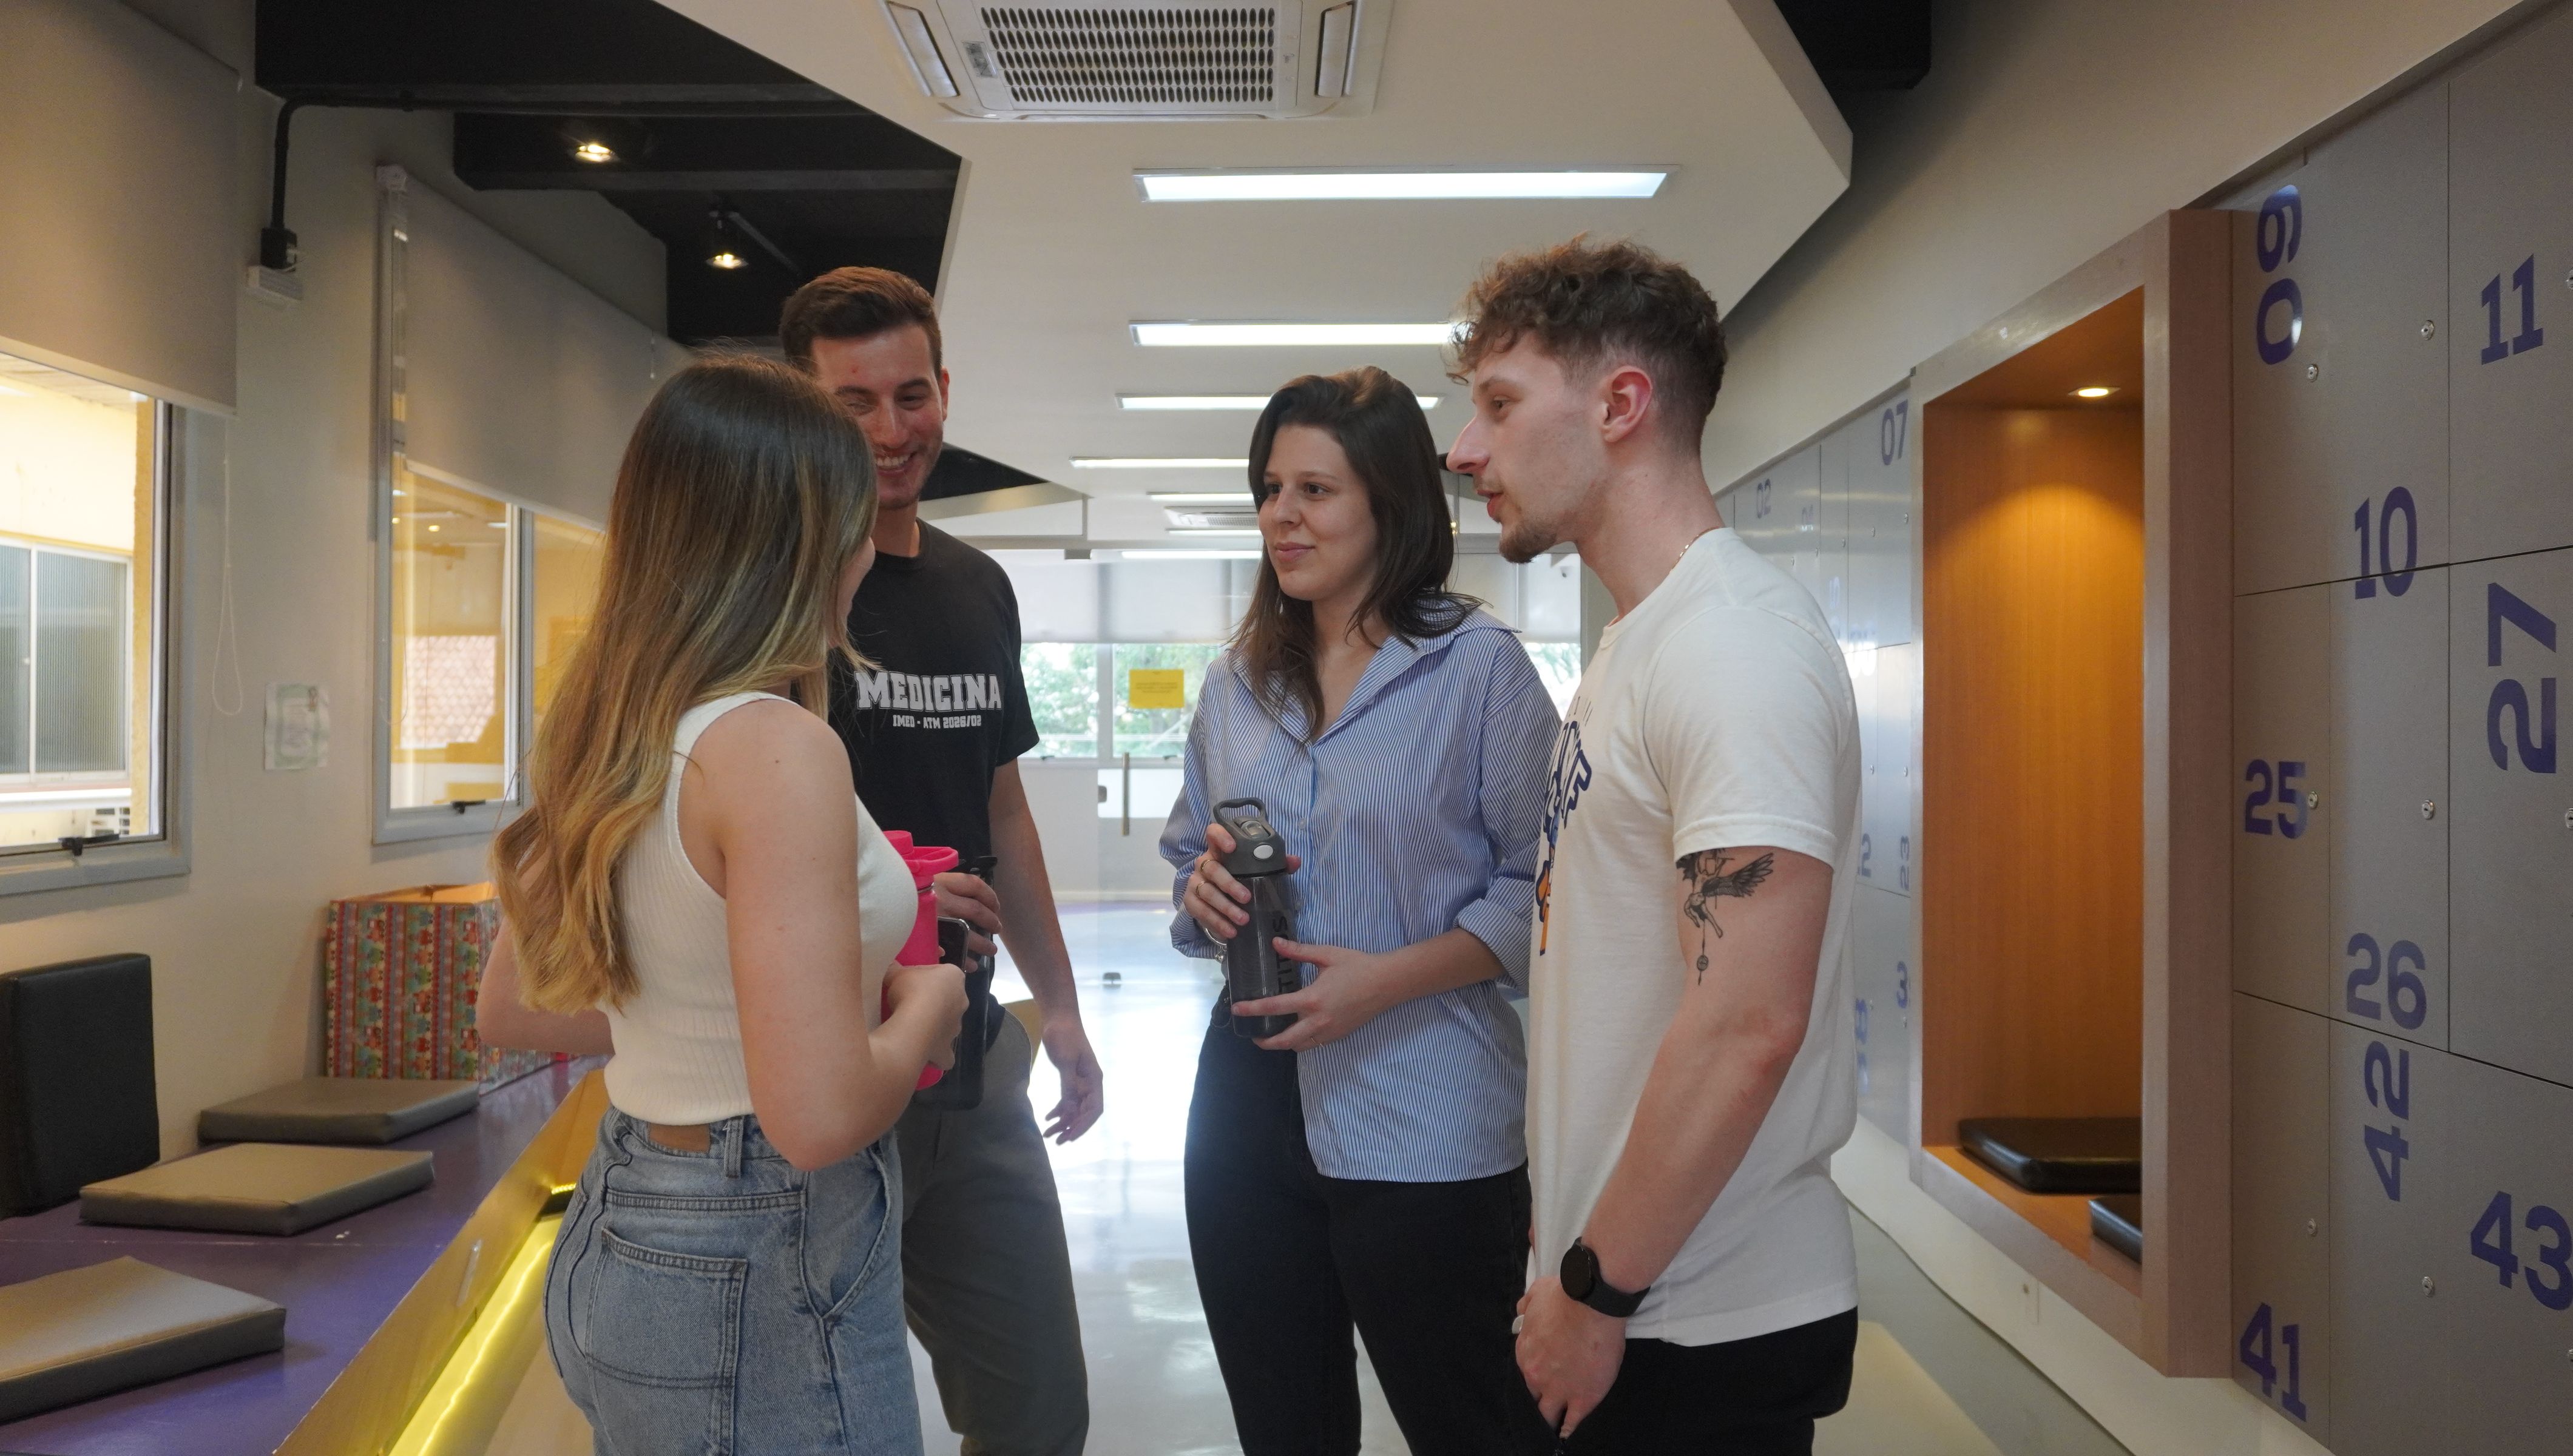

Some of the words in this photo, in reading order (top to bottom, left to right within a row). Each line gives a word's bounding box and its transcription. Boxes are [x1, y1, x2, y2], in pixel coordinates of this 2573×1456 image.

[2256, 184, 2303, 365] 09
[2481, 254, 2544, 365] 11
[1882, 399, 1909, 467] 07
[2354, 486, 2418, 599] 10
[853, 670, 1002, 713] MEDICINA
[893, 715, 915, 728] IMED
[923, 716, 941, 729] ATM
[942, 715, 982, 729] 2026/02
[2487, 582, 2557, 774] 27
[2245, 758, 2307, 840] 25
[1900, 835, 1910, 892] 23
[2346, 932, 2427, 1030] 26
[2364, 1040, 2409, 1202] 42
[2470, 1190, 2573, 1311] 43
[2239, 1302, 2307, 1423] 41
